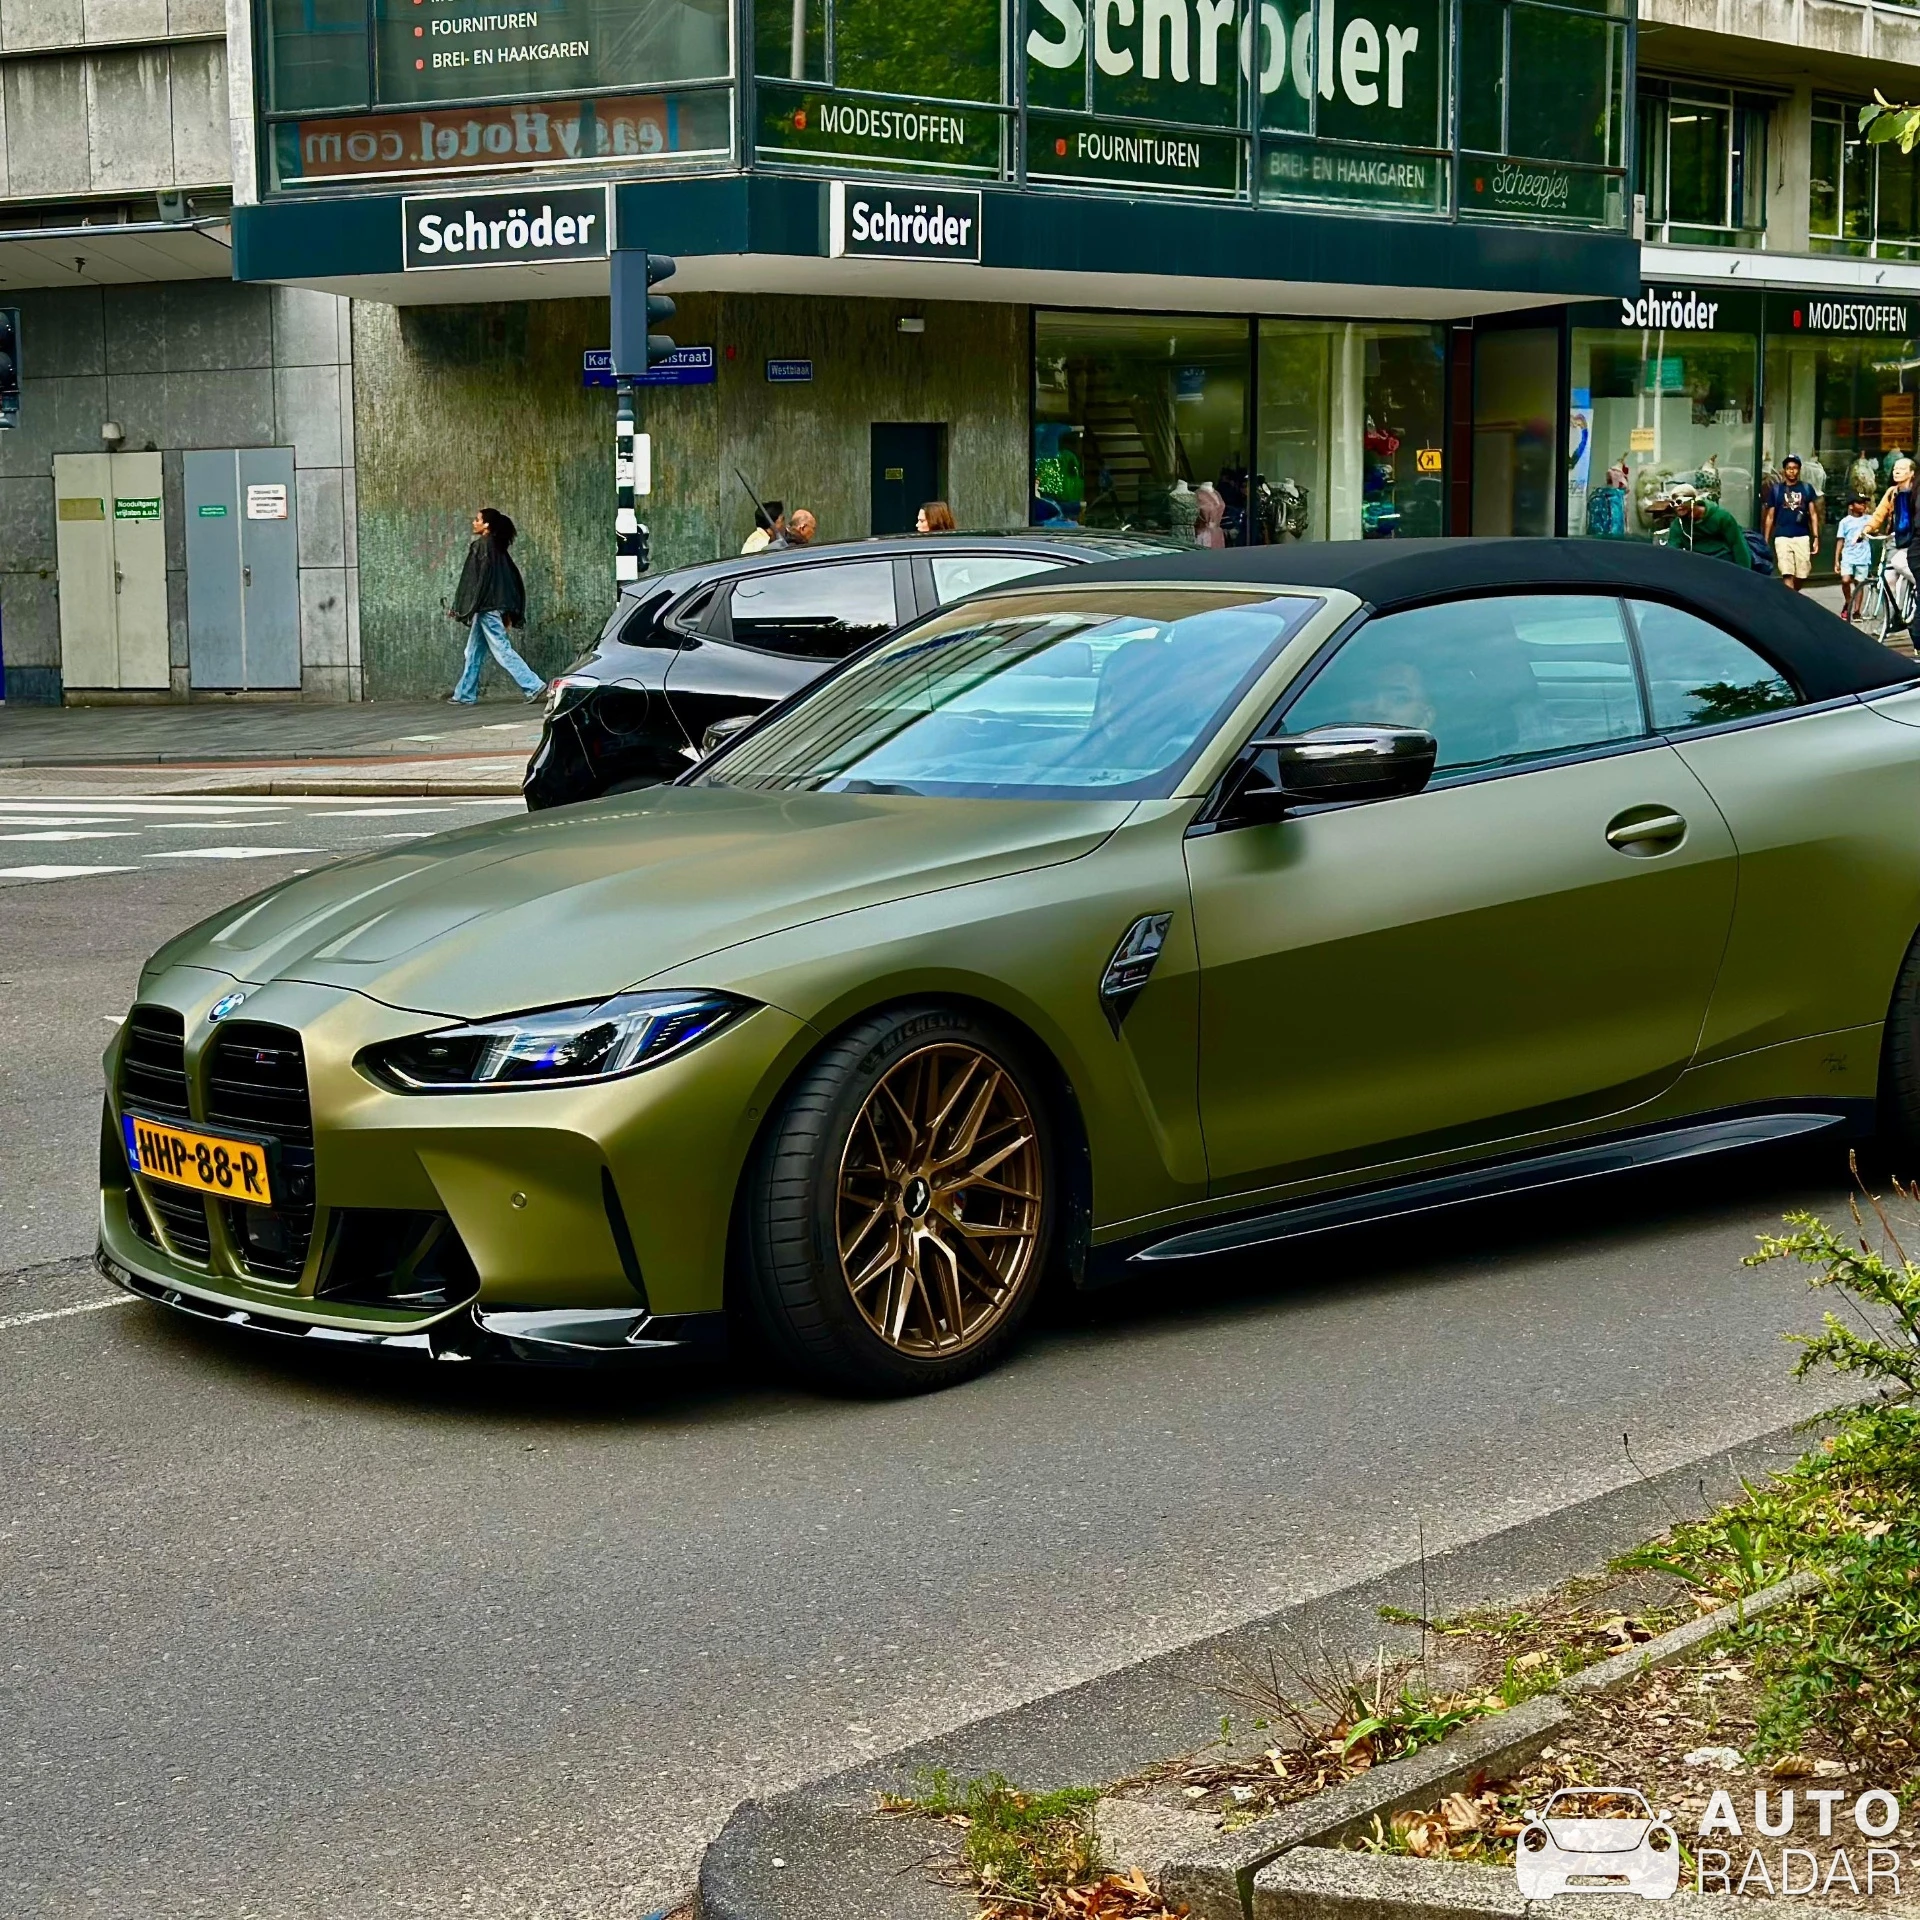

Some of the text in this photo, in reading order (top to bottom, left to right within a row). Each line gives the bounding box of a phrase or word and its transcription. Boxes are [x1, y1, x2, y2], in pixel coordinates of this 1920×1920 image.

[431, 11, 538, 36] FOURNITUREN
[432, 40, 589, 69] BREI- EN HAAKGAREN
[820, 104, 964, 145] MODESTOFFEN
[1078, 132, 1200, 168] FOURNITUREN
[1270, 151, 1425, 188] BREI- EN HAAKGAREN
[1493, 163, 1569, 208] Scheepjes
[418, 205, 596, 254] Schröder
[851, 201, 972, 246] Schröder
[1621, 288, 1719, 329] Schröder
[1808, 302, 1907, 332] MODESTOFFEN
[771, 364, 810, 376] Westblaak
[117, 501, 158, 509] Nooduitgang
[881, 1015, 968, 1053] MICHELIN
[129, 1148, 139, 1161] NL
[138, 1128, 263, 1195] HHP-88-R
